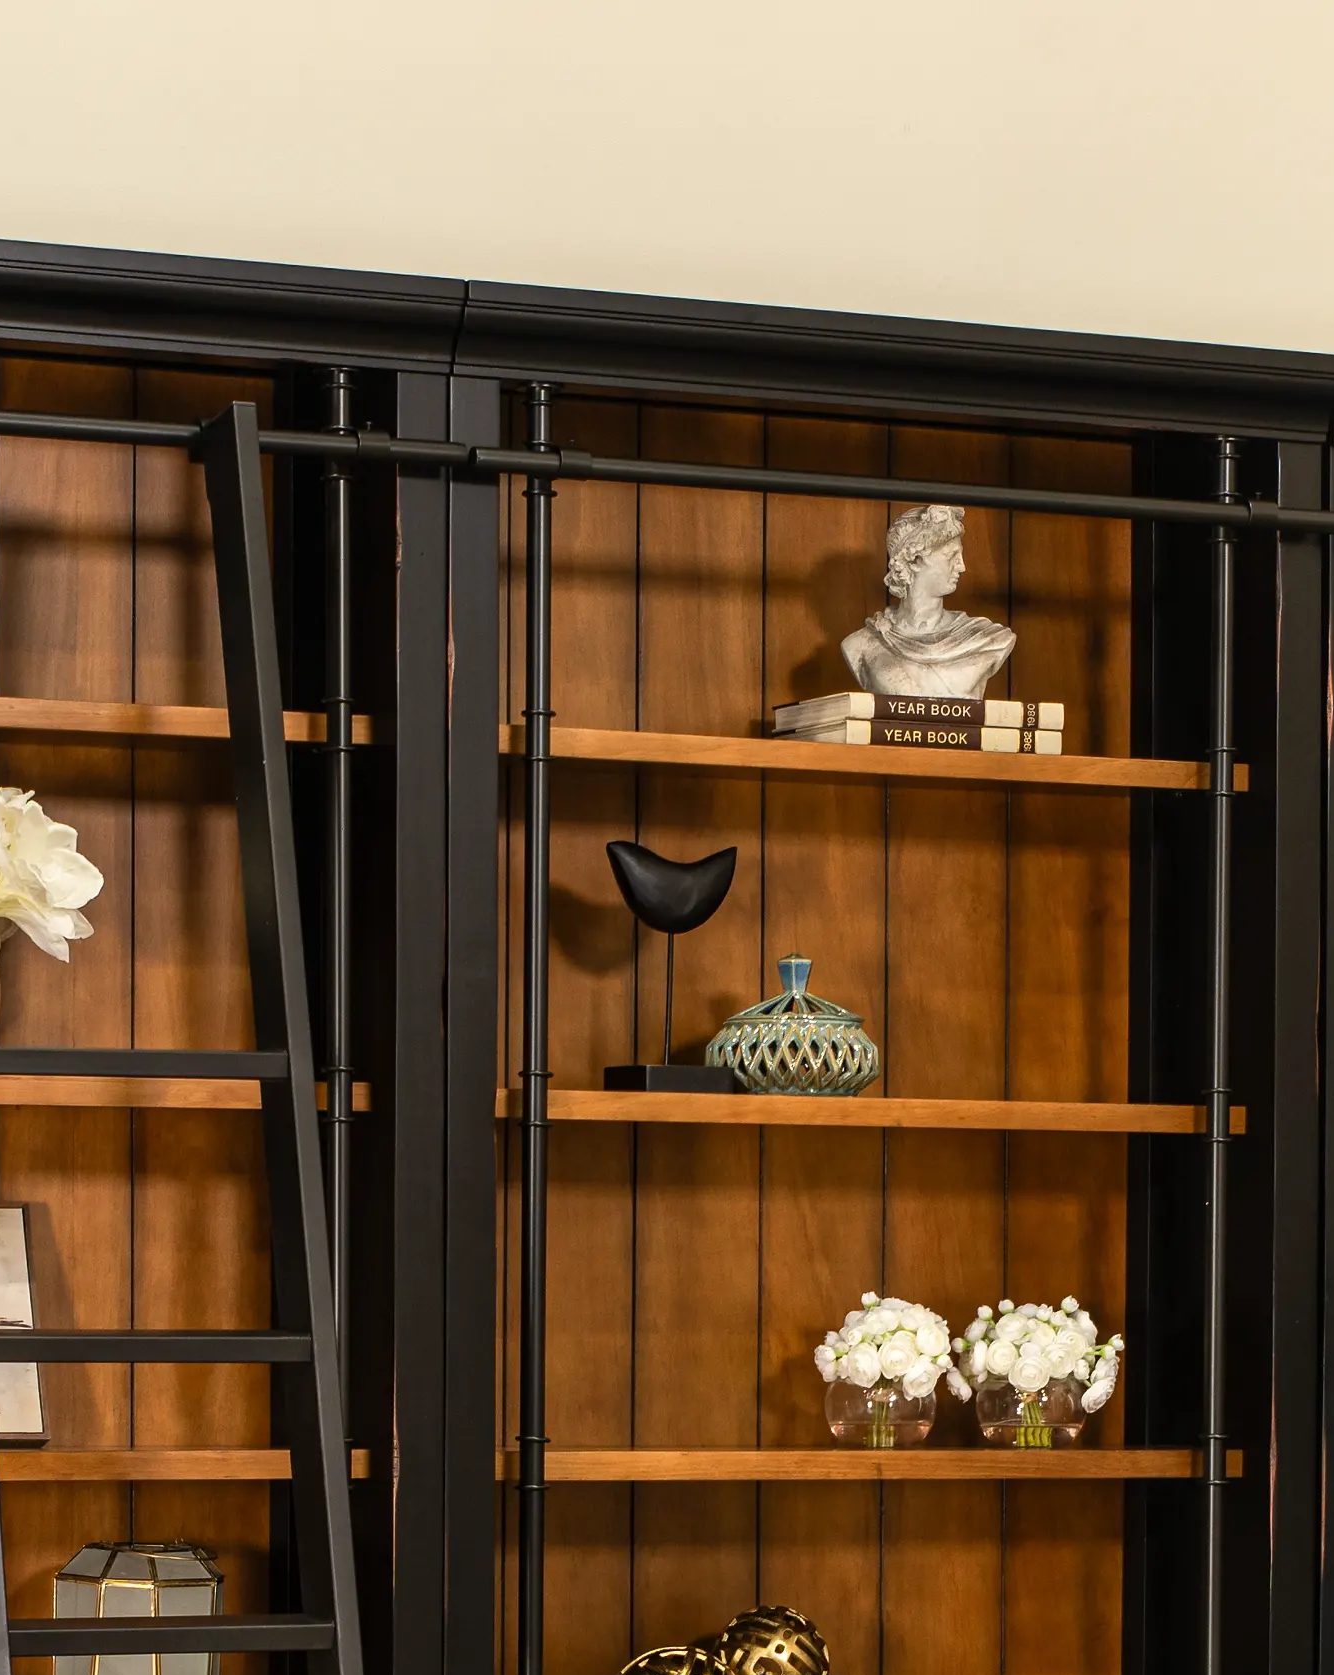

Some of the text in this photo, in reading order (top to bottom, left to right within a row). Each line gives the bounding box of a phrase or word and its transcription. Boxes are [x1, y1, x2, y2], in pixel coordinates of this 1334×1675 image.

[888, 701, 971, 717] YEAR BOOK
[1027, 703, 1036, 727] 1980
[884, 729, 968, 744] YEAR BOOK
